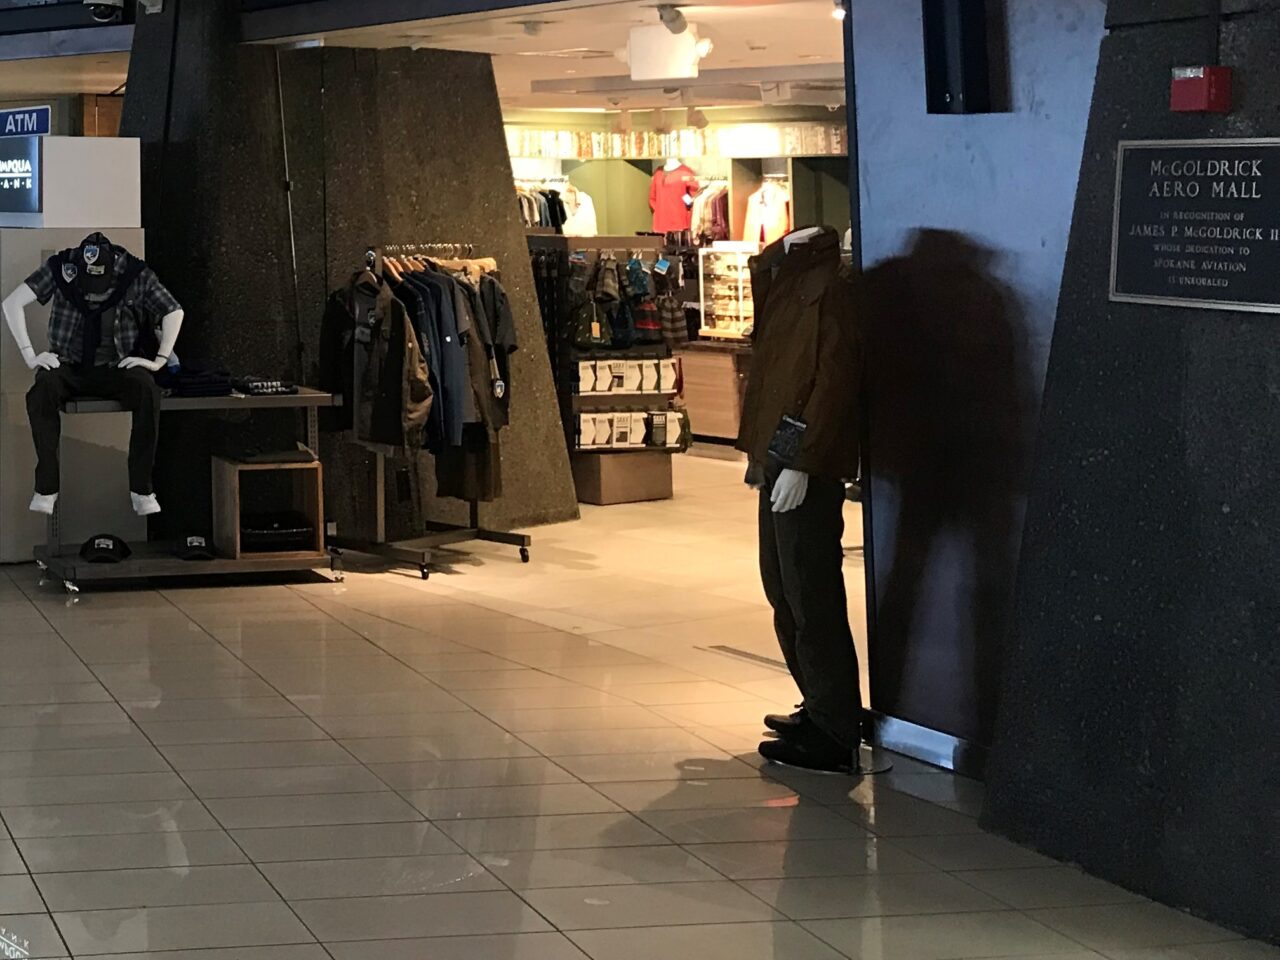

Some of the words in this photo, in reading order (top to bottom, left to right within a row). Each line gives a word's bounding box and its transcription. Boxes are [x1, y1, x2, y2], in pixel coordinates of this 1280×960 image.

[5, 112, 37, 133] ATM
[1150, 160, 1263, 176] McGOLDRICK
[1149, 181, 1200, 197] AERO
[1211, 181, 1262, 198] MALL
[1234, 212, 1245, 221] OF
[1128, 224, 1165, 237] JAMES
[1239, 246, 1250, 256] TO
[1201, 260, 1247, 272] AVIATION
